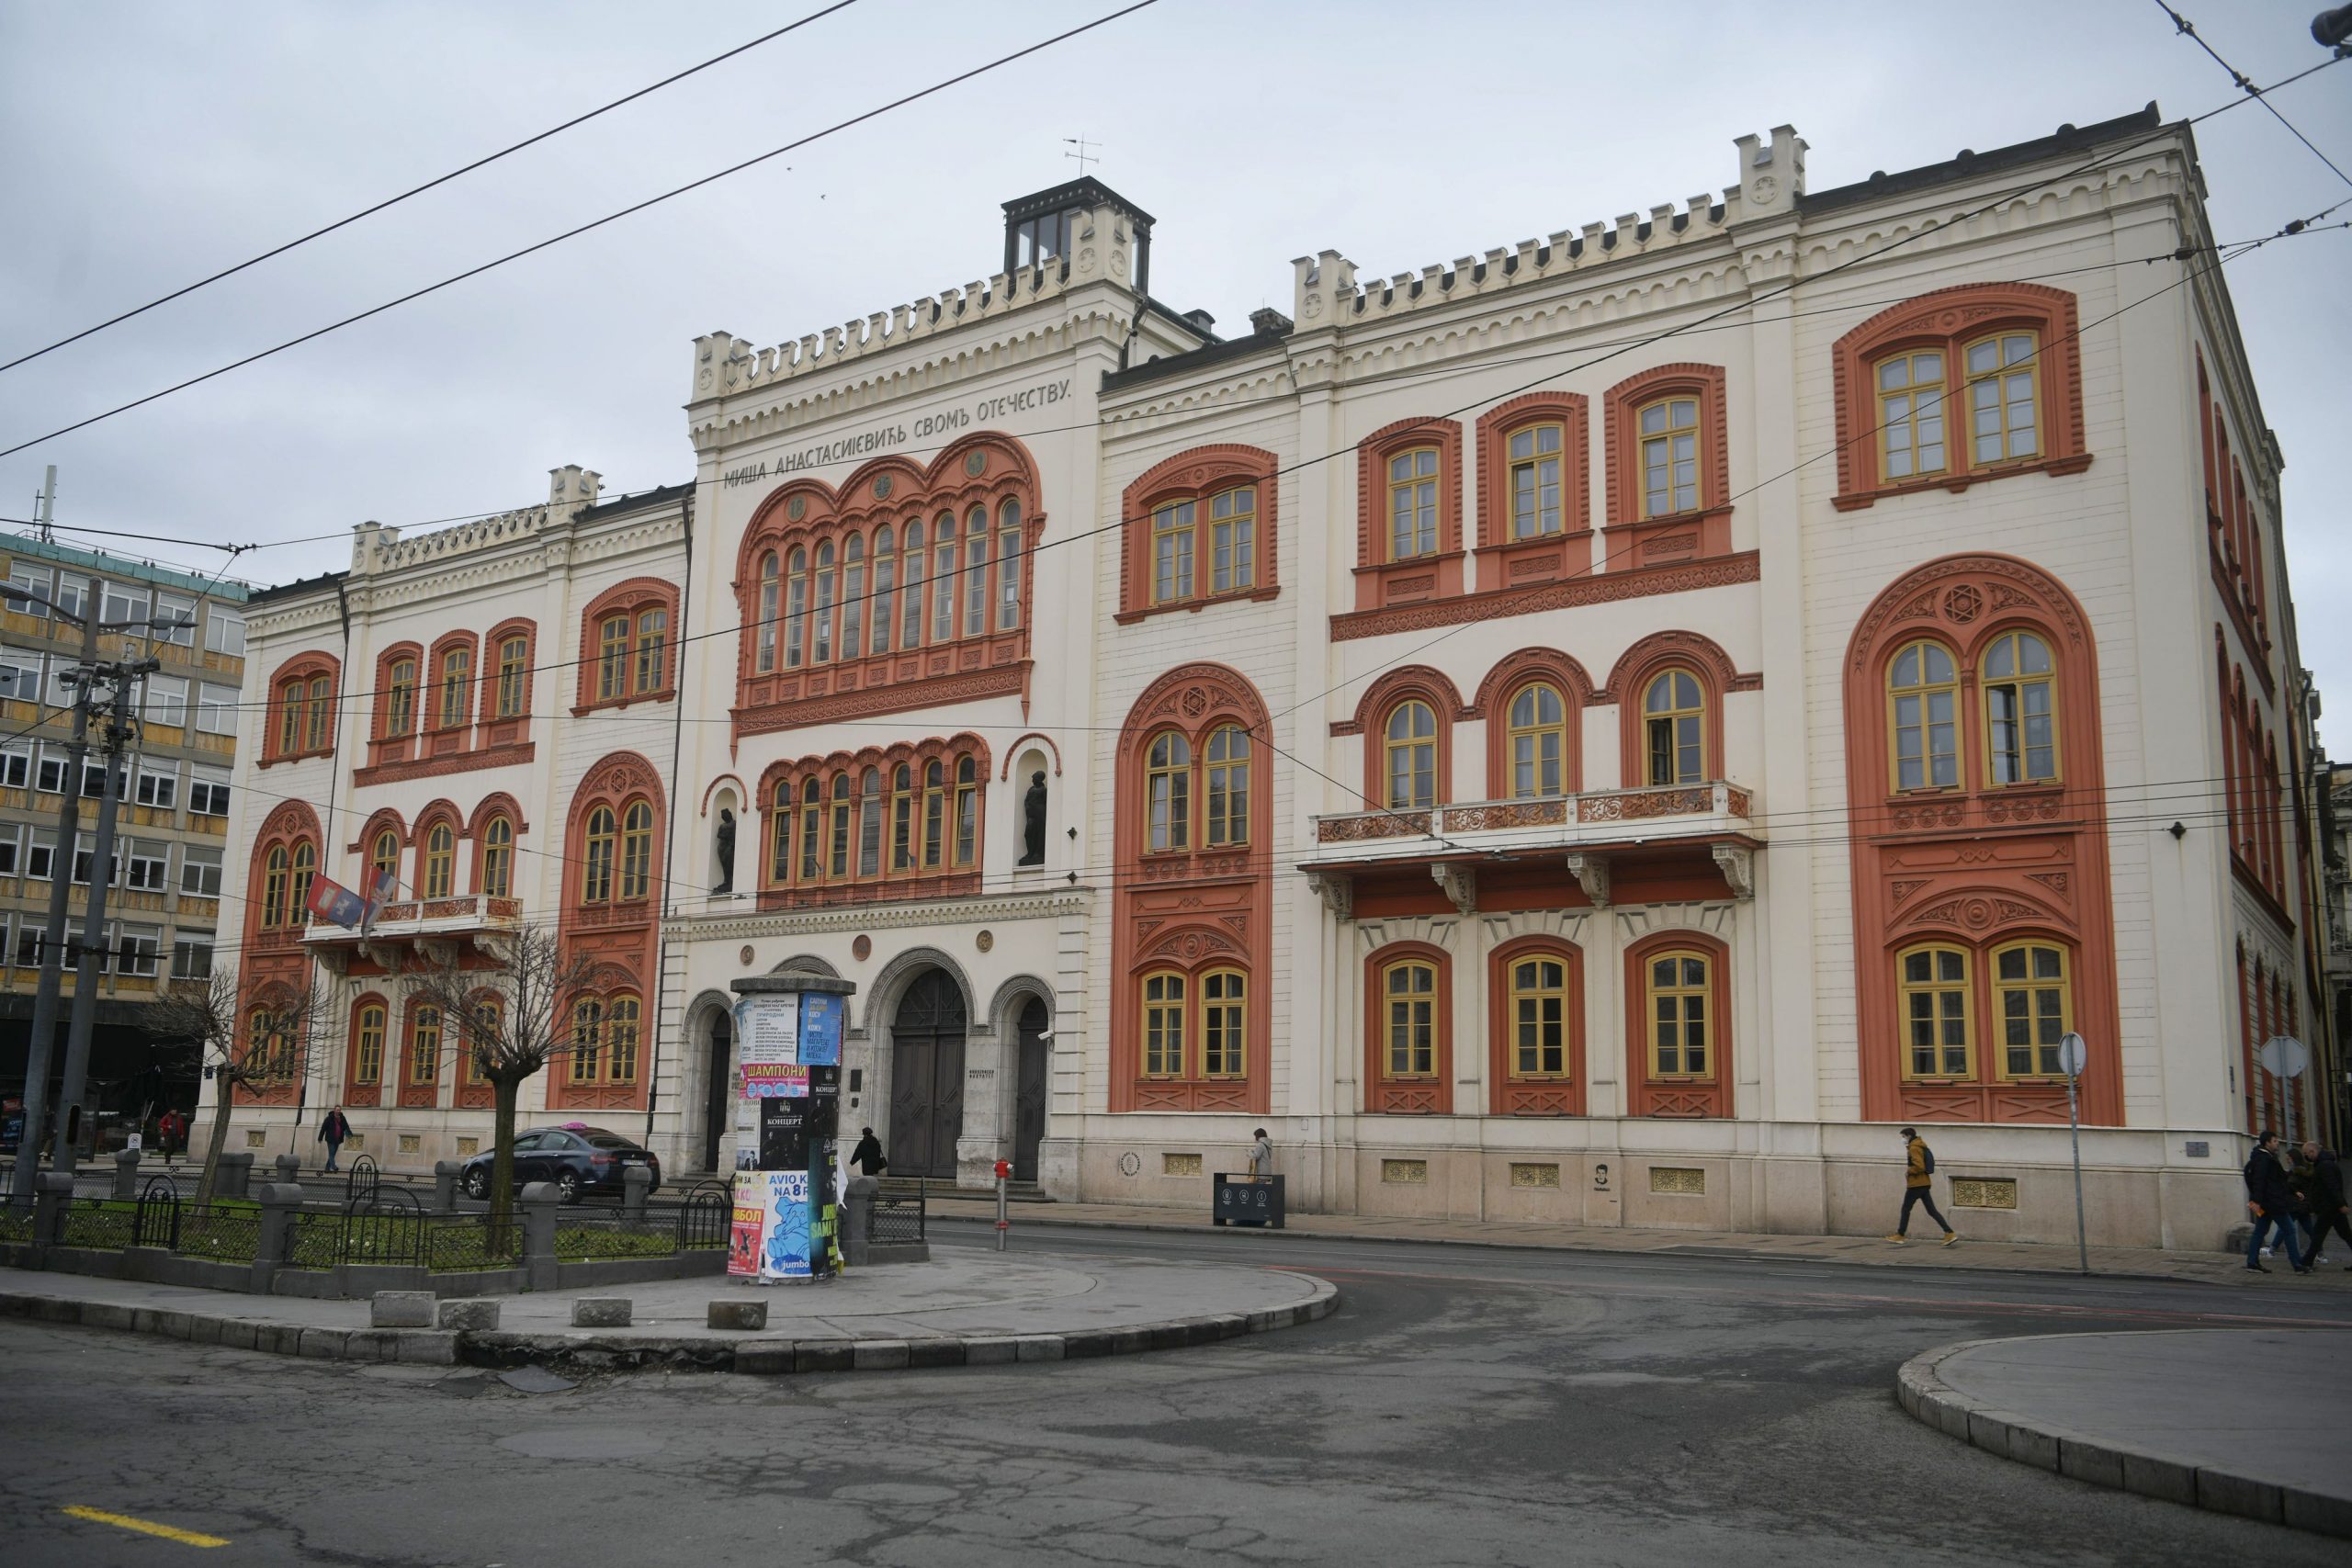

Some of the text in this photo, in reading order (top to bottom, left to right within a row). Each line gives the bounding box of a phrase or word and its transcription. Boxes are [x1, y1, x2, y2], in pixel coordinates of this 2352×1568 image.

[724, 461, 766, 490] МИША
[748, 1065, 807, 1077] ШАМПОНИ
[767, 1118, 802, 1126] КОНЦЕРТ
[769, 1174, 797, 1185] AVIO
[775, 1187, 790, 1197] NA
[792, 1184, 801, 1196] 8
[782, 1259, 809, 1269] jumbo
